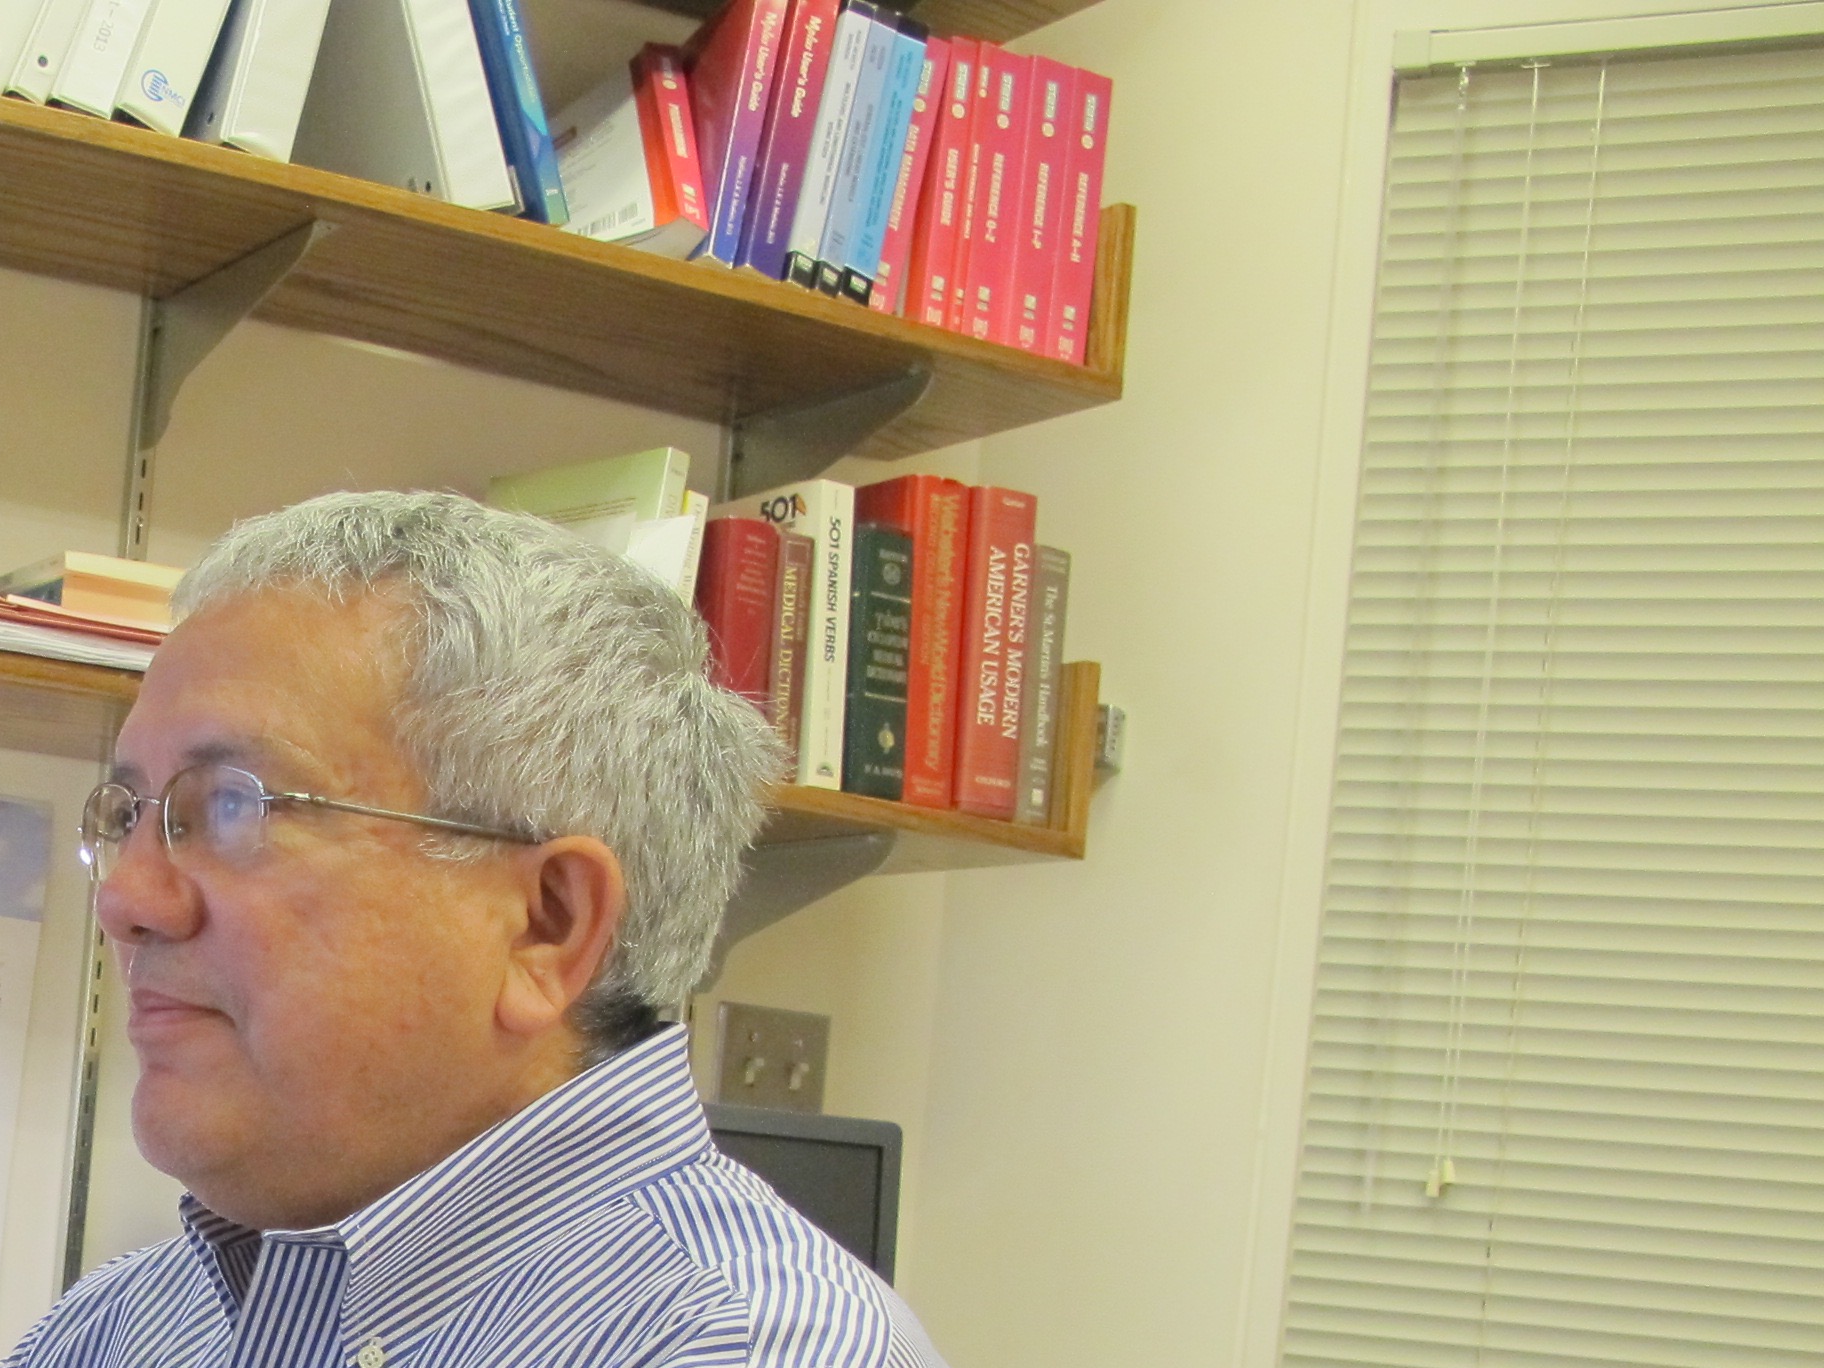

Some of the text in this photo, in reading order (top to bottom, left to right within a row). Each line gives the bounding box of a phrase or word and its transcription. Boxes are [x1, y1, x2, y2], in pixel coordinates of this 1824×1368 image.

[748, 12, 778, 113] Mplus User's Guide
[791, 16, 822, 118] Mplus User's Guide
[940, 148, 959, 226] USER'S GUIDE
[988, 152, 1005, 218] REFERENCE
[1034, 162, 1050, 227] REFERENCE
[1072, 172, 1089, 237] REFERENCE
[780, 566, 798, 641] MEDICAL
[824, 515, 842, 663] 501 SPANISH VERBS
[1044, 586, 1059, 610] The
[977, 545, 1007, 727] AMERICAN USAGE
[1001, 542, 1031, 741] GARNER'S MODERN
[1035, 682, 1052, 748] Handbook
